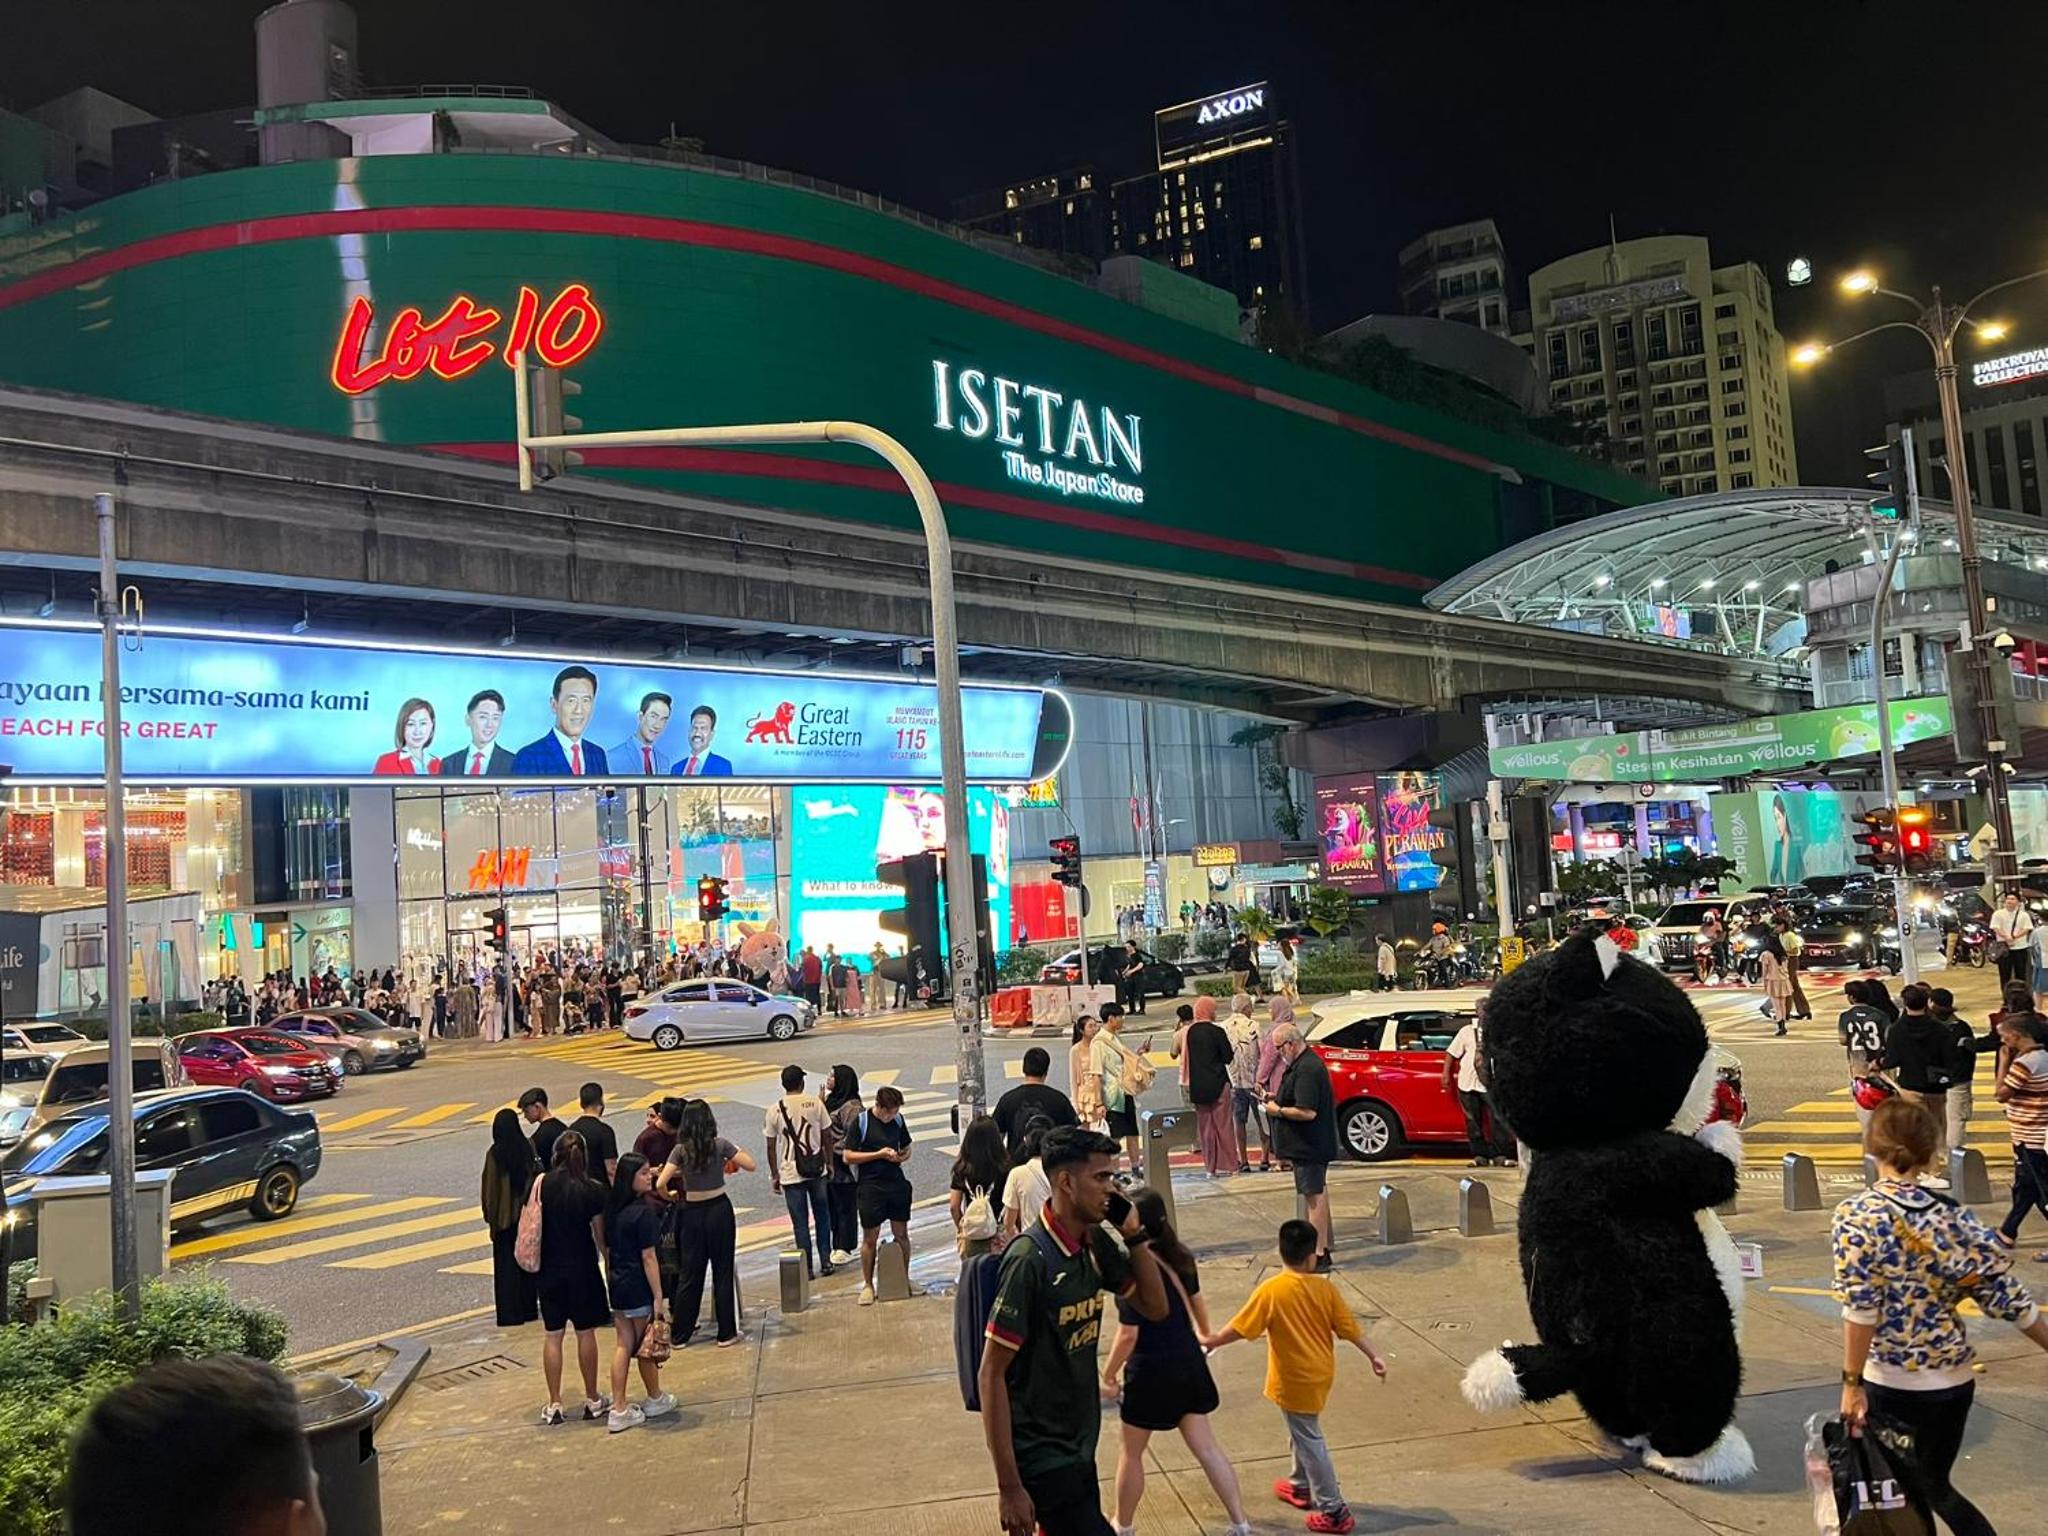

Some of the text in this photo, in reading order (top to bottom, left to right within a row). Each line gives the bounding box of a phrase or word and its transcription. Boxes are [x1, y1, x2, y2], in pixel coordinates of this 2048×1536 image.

[1197, 89, 1263, 124] AXON
[331, 284, 601, 393] Lot 10
[932, 360, 1143, 475] ISETAN
[1002, 451, 1144, 504] The Japan Store
[310, 690, 369, 711] kami
[801, 703, 850, 724] Great
[138, 722, 218, 739] GREAT
[798, 725, 862, 746] Eastern
[896, 727, 926, 750] 115
[1698, 727, 1738, 741] Bintang
[1503, 752, 1560, 768] Wellous
[1616, 742, 1816, 774] Stesen Kesihatan Wellous
[1386, 832, 1445, 855] PERAWAN
[810, 880, 841, 891] What
[0, 945, 23, 968] ife
[1848, 1021, 1880, 1051] 23
